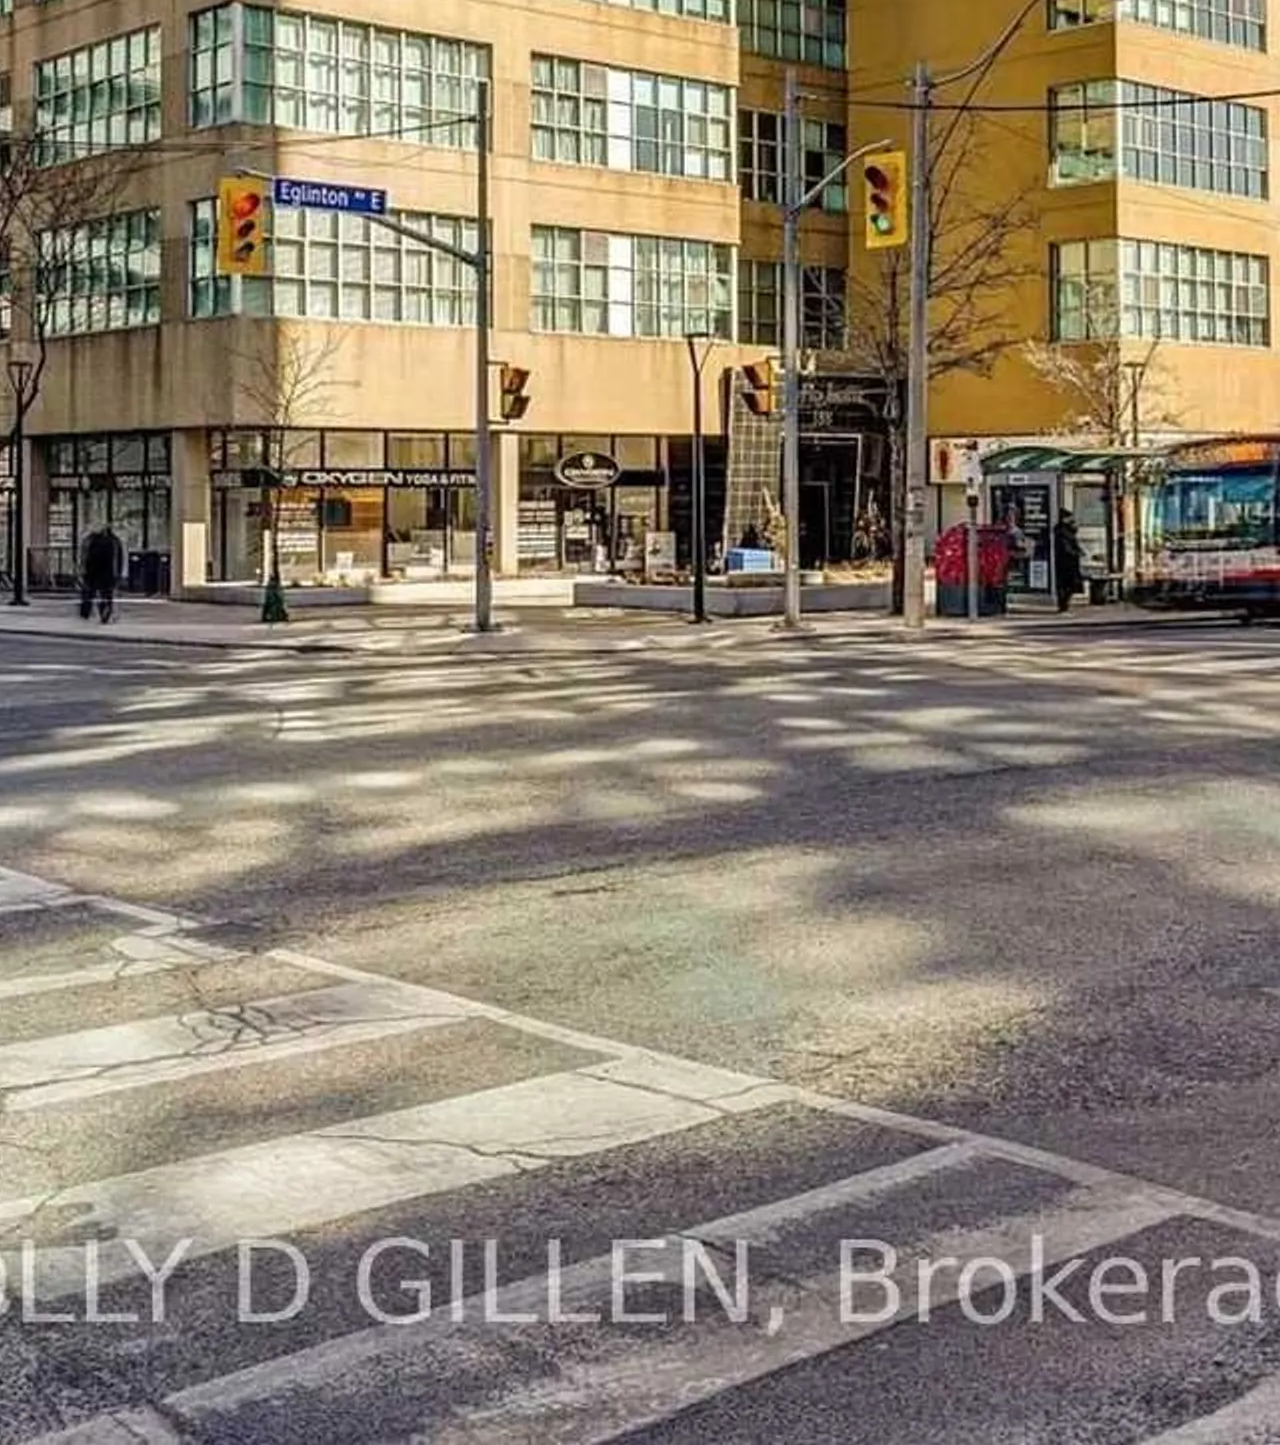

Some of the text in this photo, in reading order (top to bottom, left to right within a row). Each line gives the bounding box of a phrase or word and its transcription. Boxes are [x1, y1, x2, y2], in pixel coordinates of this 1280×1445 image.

[281, 181, 349, 207] Eglinton
[371, 191, 381, 210] E
[301, 470, 404, 485] OXYGEN
